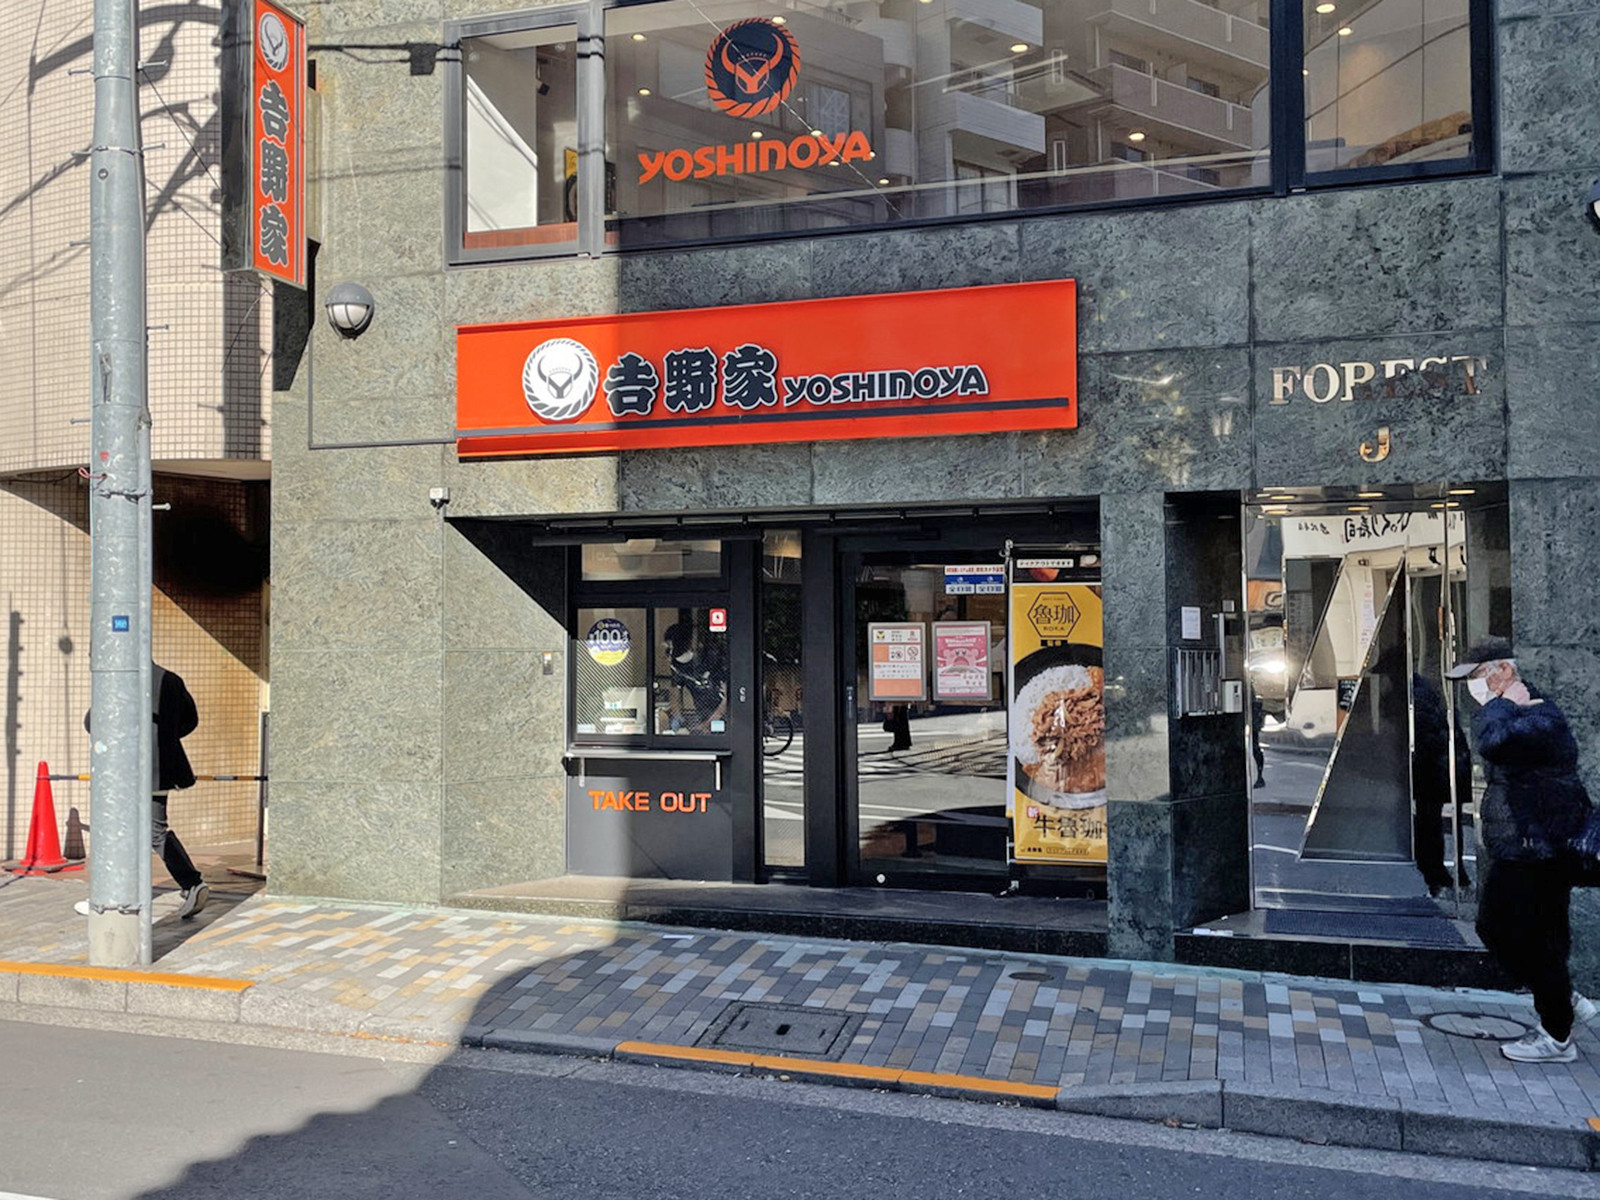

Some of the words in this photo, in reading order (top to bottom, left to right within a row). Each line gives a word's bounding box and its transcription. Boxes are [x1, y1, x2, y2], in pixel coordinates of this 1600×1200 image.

[638, 131, 873, 184] YOSHINOYA
[782, 364, 989, 407] YOSHINOYA
[1359, 426, 1391, 463] J
[587, 790, 650, 811] TAKE
[660, 791, 712, 813] OUT
[1033, 815, 1107, 838] 牛魯珈
